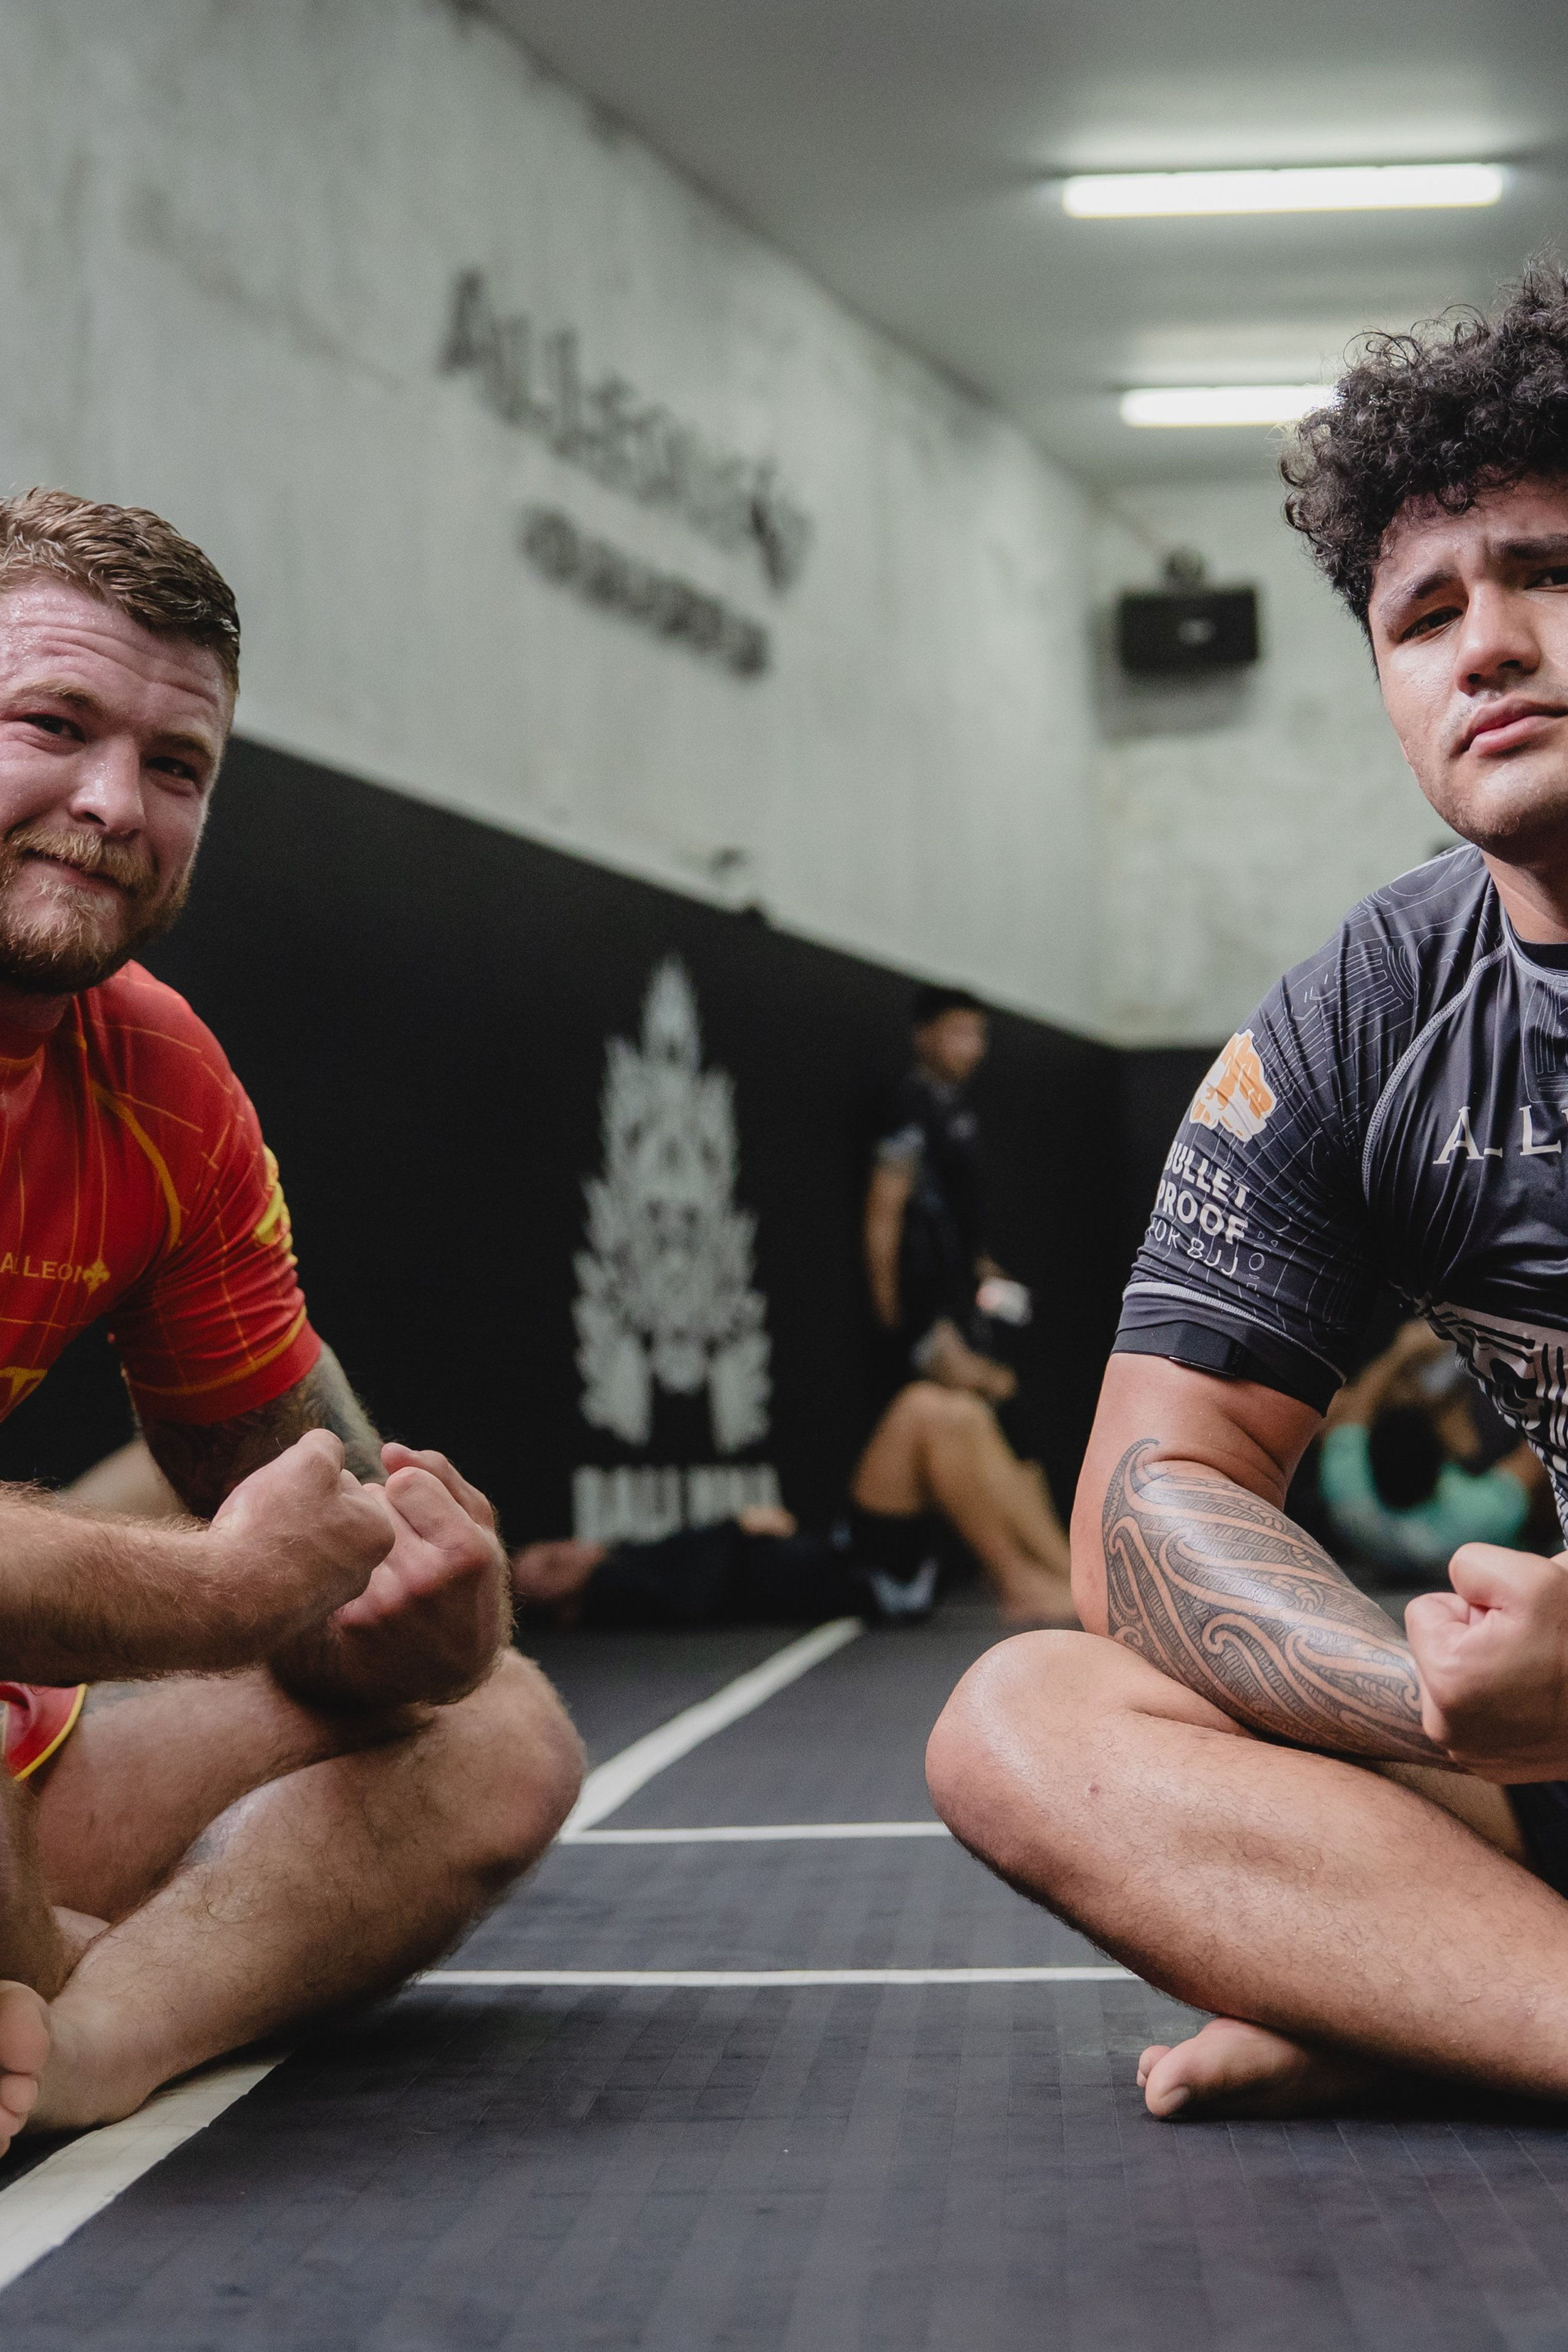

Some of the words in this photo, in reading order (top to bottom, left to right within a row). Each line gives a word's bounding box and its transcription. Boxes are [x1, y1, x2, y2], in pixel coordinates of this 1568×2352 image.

[1164, 1140, 1250, 1209] BULLET
[1155, 1179, 1248, 1245] PROOF
[1186, 1237, 1238, 1275] BJJ
